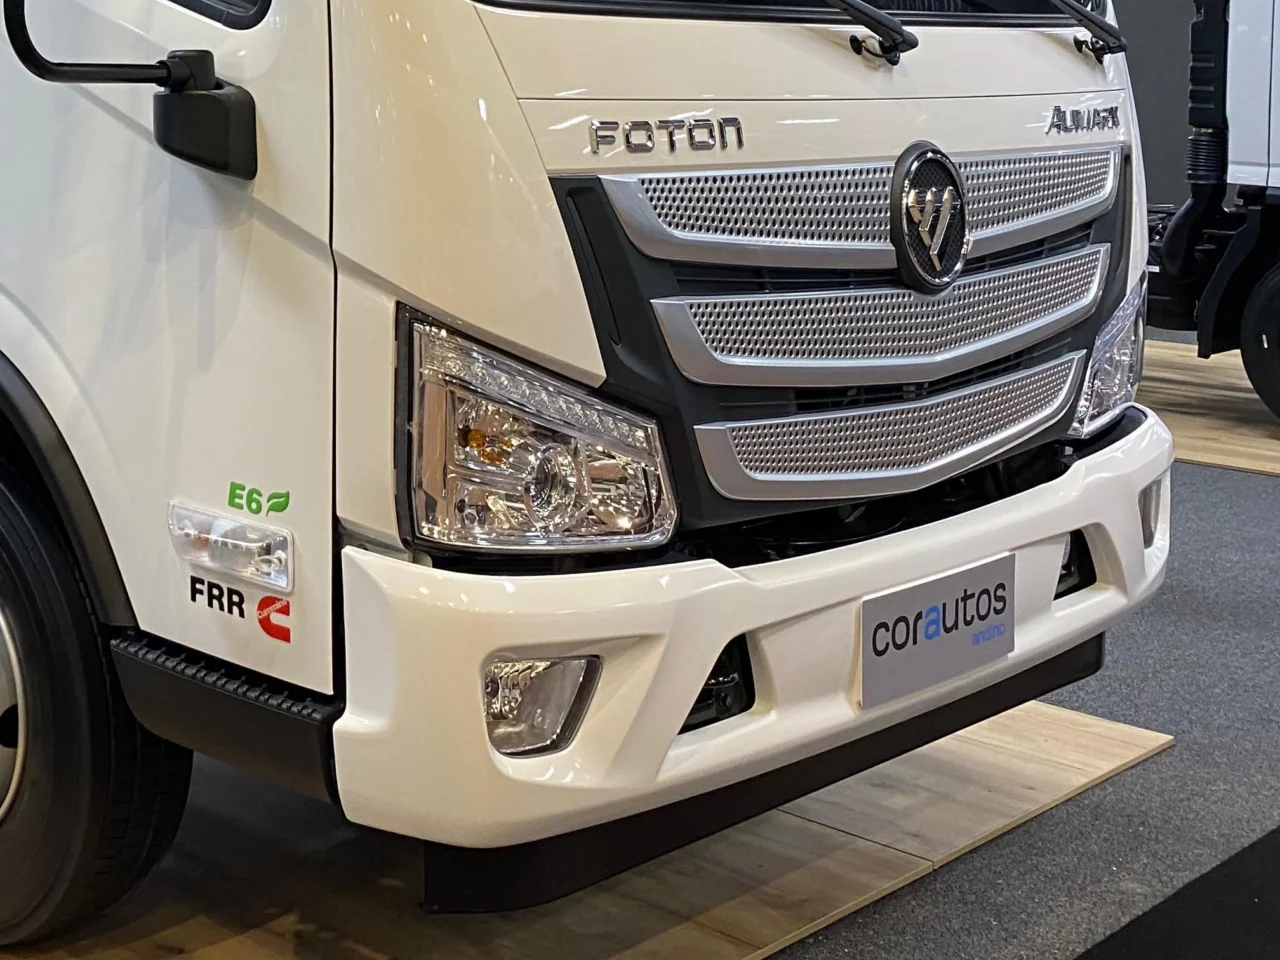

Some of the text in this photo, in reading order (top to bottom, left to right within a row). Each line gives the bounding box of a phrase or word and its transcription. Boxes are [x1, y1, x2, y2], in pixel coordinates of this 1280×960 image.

[589, 117, 745, 154] FOTON
[227, 481, 263, 515] E6
[190, 575, 245, 619] FRR
[872, 582, 1007, 657] corautos
[971, 623, 1006, 646] andino
